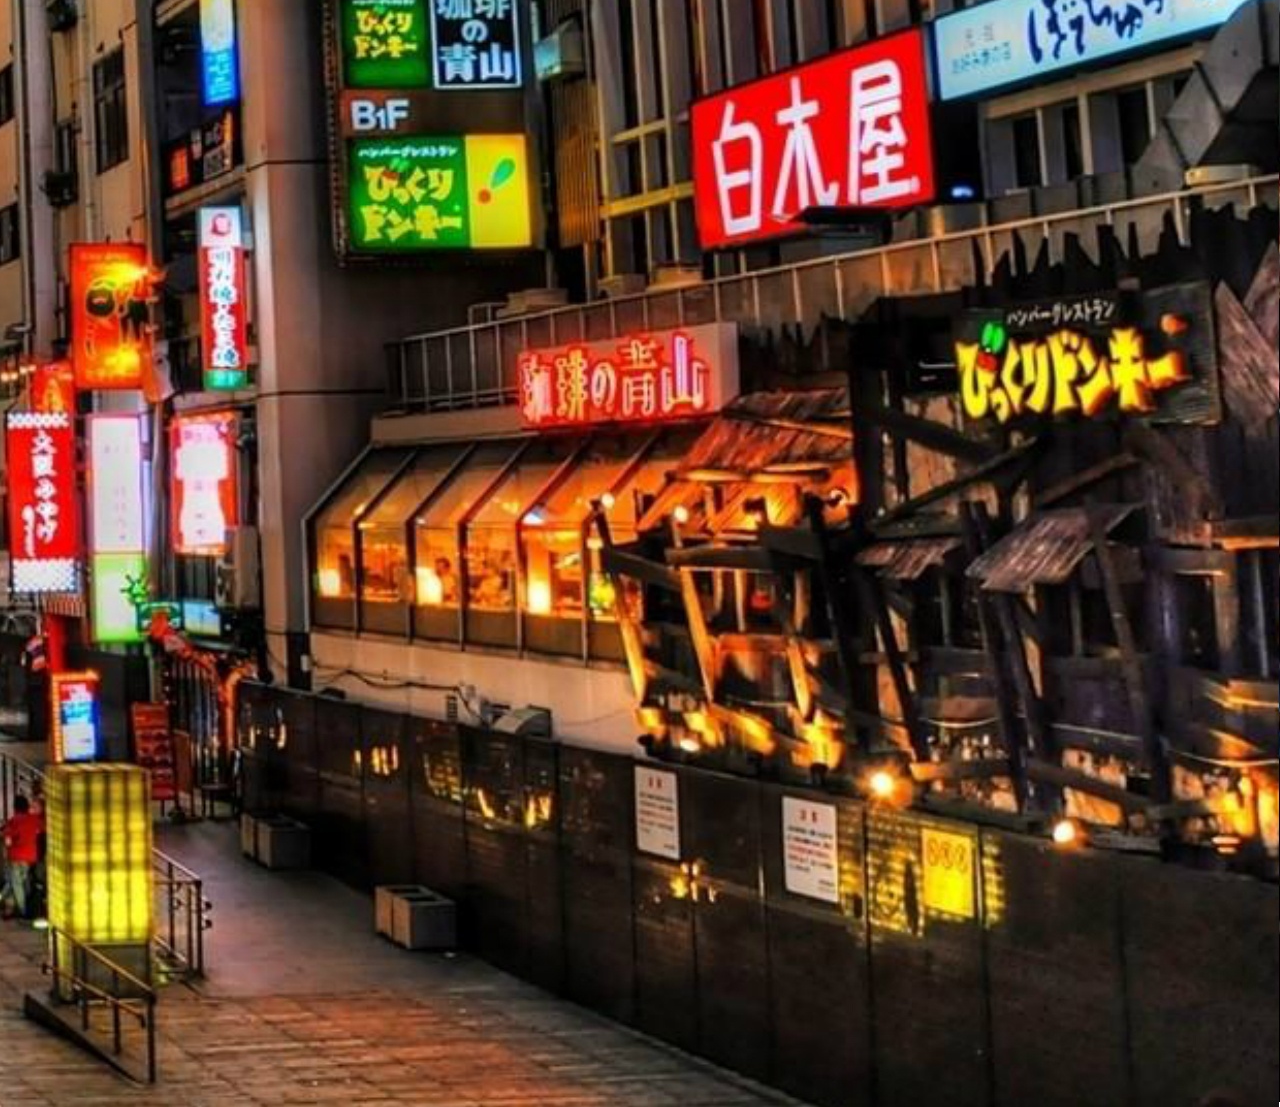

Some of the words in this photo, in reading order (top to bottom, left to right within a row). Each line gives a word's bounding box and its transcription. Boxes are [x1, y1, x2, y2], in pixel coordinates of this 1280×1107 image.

[354, 8, 412, 36] びっくり
[461, 19, 489, 44] の
[353, 35, 419, 60] ドンキー
[438, 42, 515, 83] 青山
[350, 99, 410, 131] B1F
[711, 57, 920, 237] 白木屋
[363, 163, 453, 206] びっくり
[358, 204, 464, 244] ドンキー
[519, 332, 708, 424] 珈琲の青山
[955, 326, 1187, 422] びっくりドンキー
